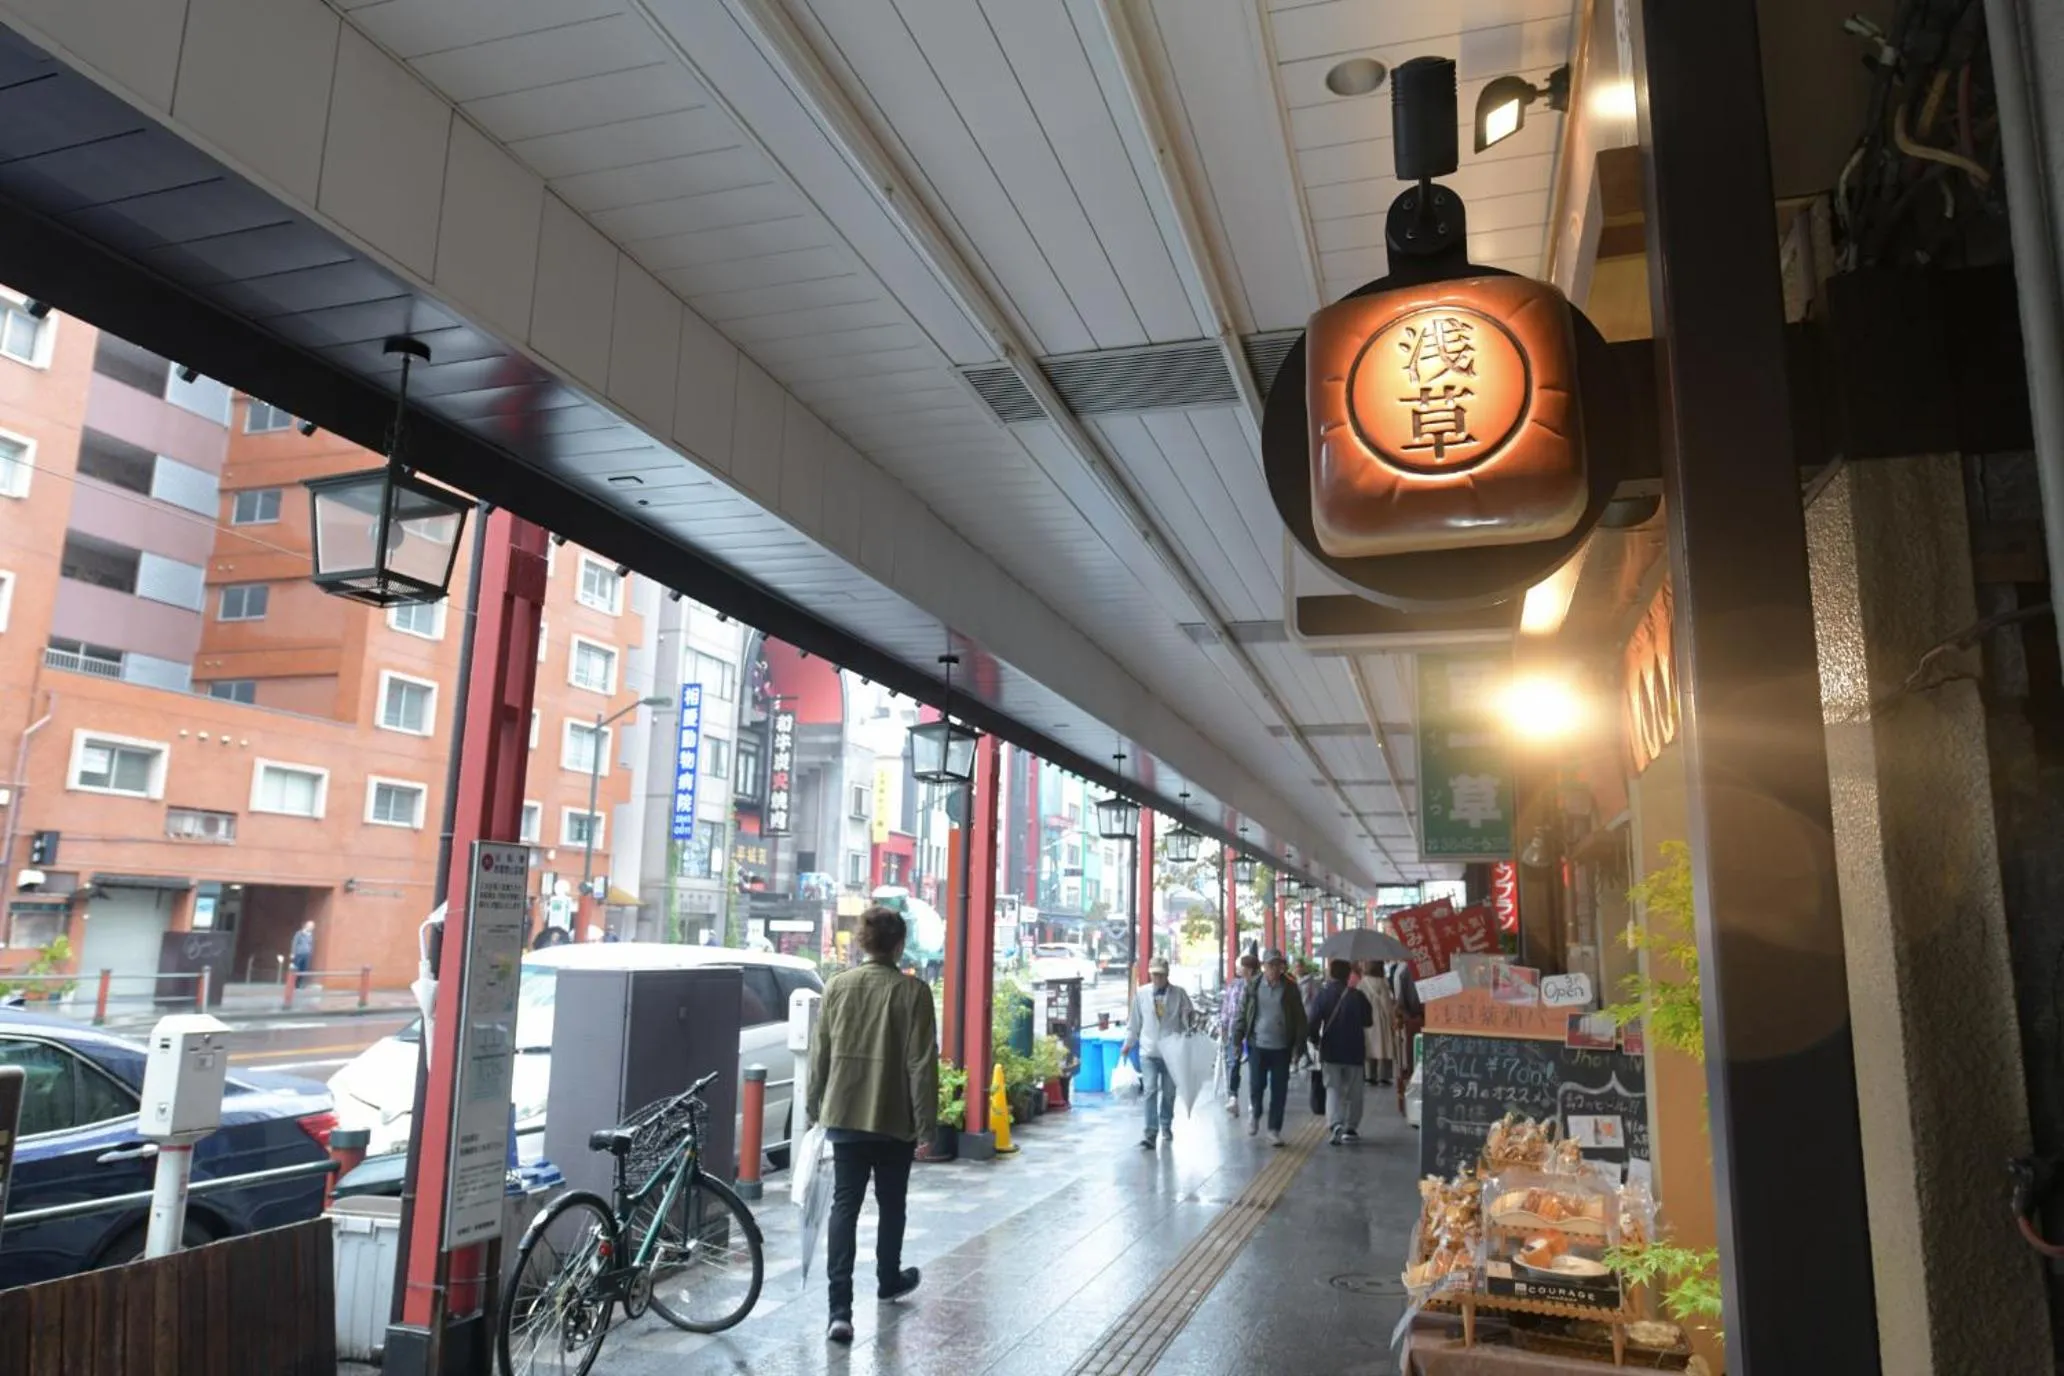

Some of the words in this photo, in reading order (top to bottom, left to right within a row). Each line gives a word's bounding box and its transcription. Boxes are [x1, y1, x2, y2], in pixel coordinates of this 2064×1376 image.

[1397, 316, 1481, 461] 浅草
[1543, 981, 1585, 1003] Open
[1443, 1056, 1482, 1078] ALL
[1528, 1285, 1597, 1301] COURAGE
